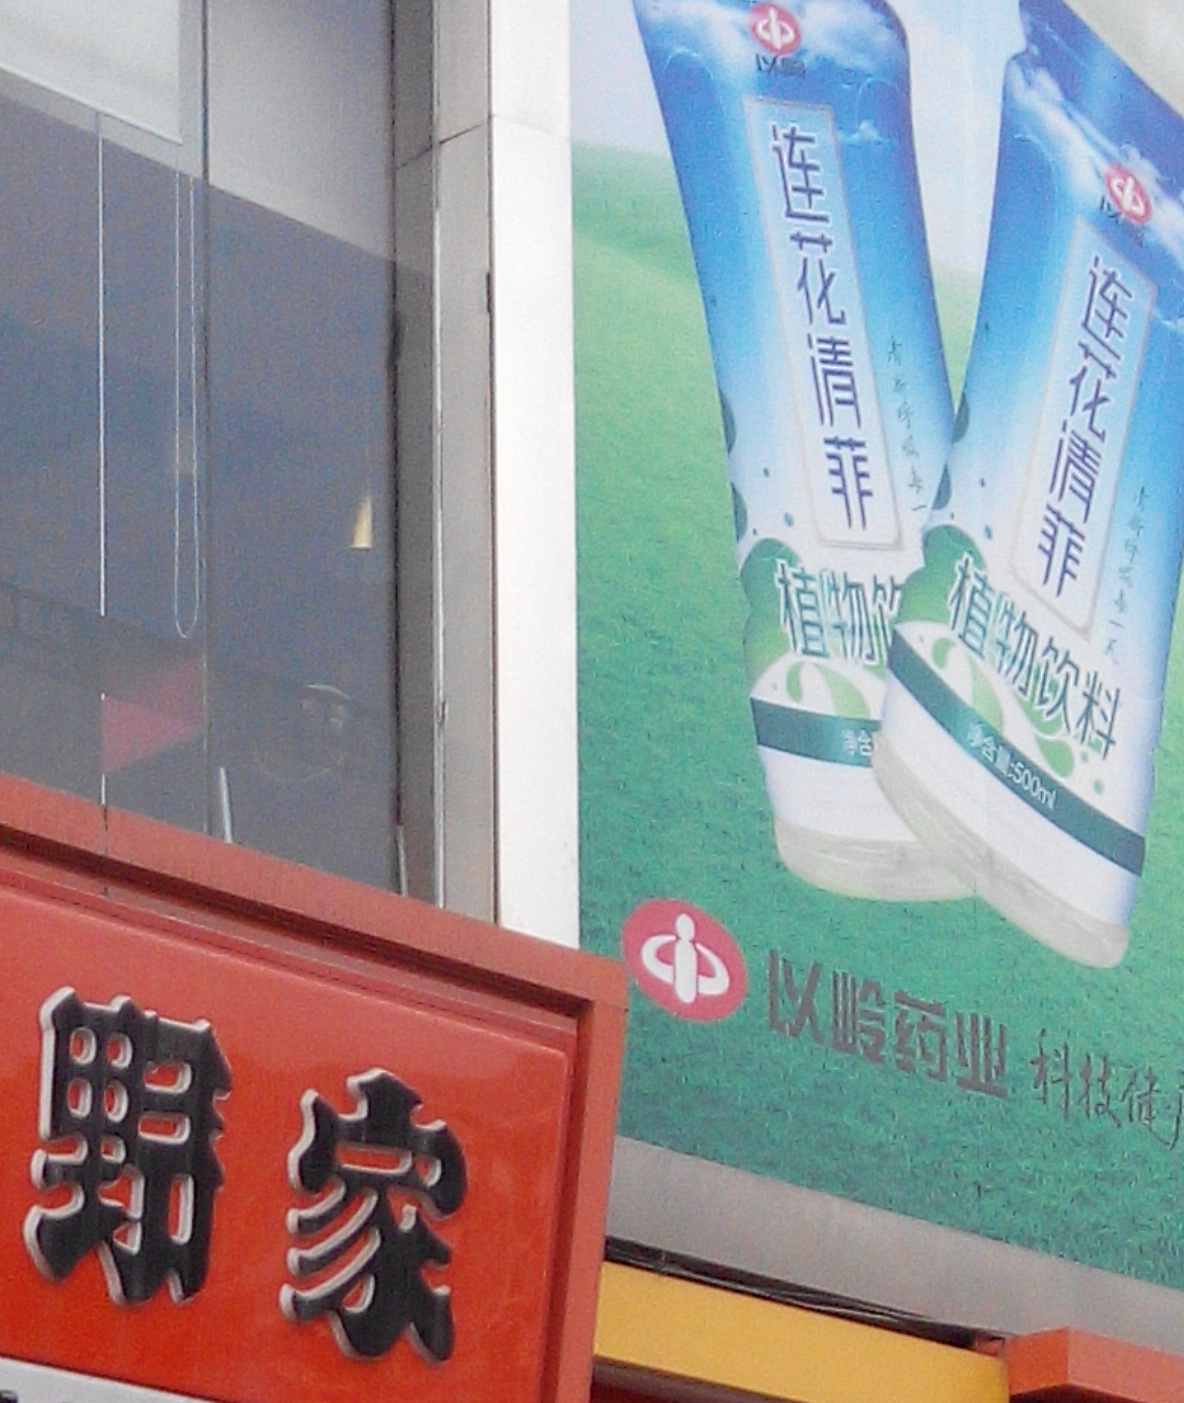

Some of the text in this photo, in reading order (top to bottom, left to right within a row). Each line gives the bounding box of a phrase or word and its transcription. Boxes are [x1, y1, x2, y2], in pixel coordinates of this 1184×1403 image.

[947, 555, 1121, 761] 植物饮料
[769, 950, 1184, 1153] 以岭药业 科技健
